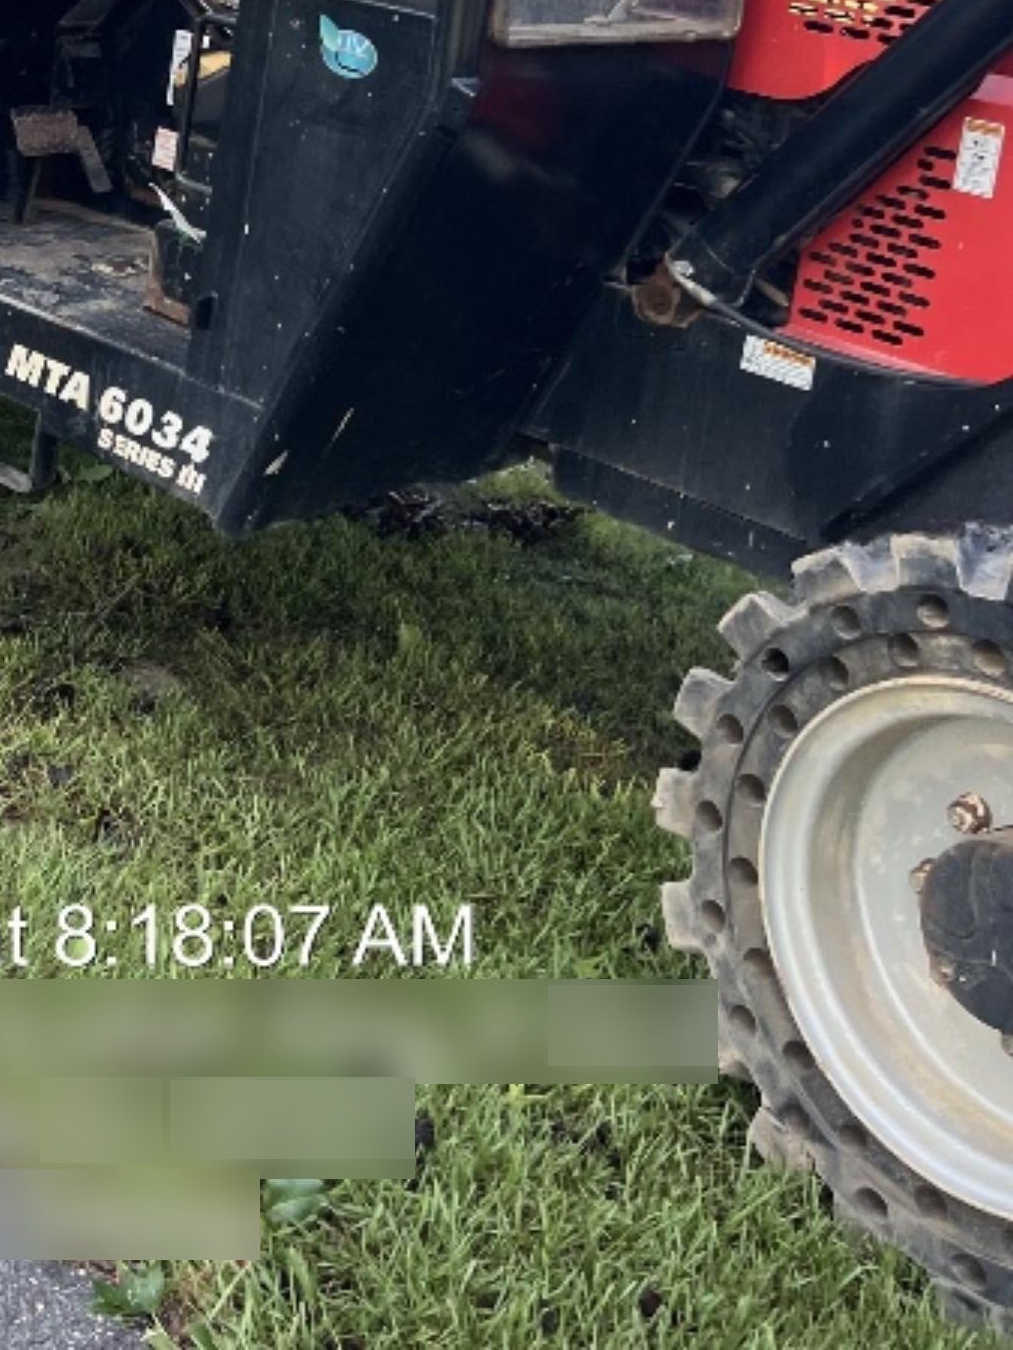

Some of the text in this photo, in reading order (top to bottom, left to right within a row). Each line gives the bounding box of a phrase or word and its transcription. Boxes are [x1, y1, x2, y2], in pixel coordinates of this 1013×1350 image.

[4, 343, 214, 463] MTA 6034
[97, 428, 177, 479] SERIES
